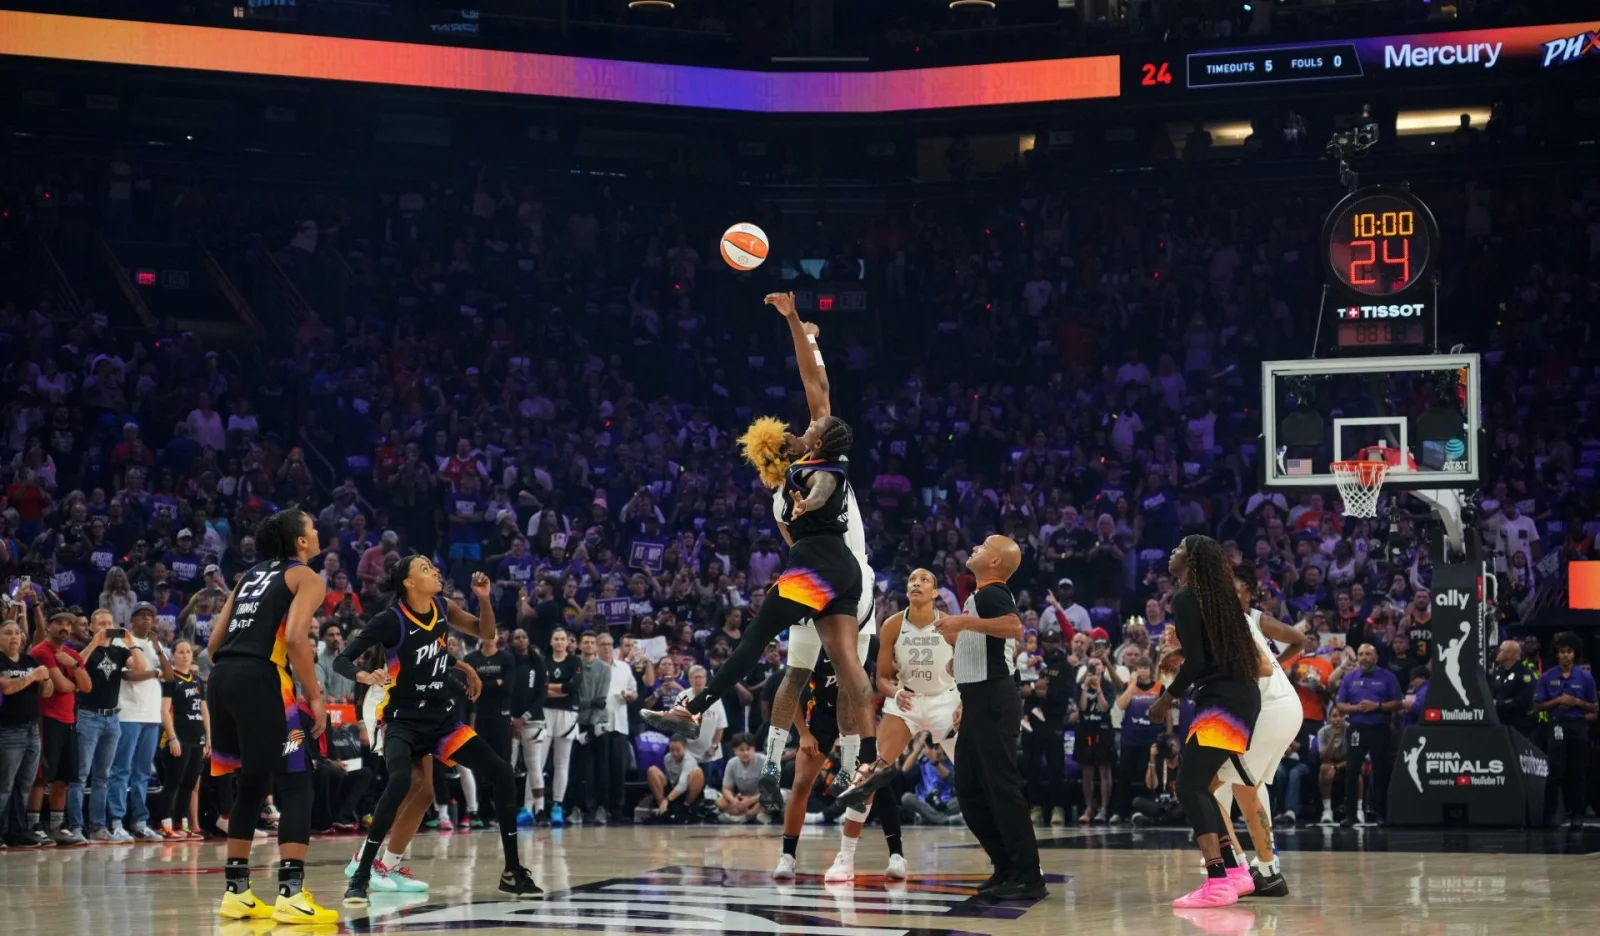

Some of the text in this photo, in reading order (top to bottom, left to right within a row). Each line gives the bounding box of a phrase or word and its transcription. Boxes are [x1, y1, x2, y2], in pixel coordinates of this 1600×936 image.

[1291, 55, 1342, 69] FOULS 0
[1385, 42, 1503, 68] Mercury
[1141, 62, 1172, 86] 24
[1206, 60, 1273, 74] TIMEOUTS 5
[1354, 211, 1414, 238] 10:00
[1350, 238, 1409, 284] 24
[1360, 304, 1425, 318] TISSOT
[1443, 460, 1468, 471] AT&T
[237, 570, 281, 598] 25
[1436, 590, 1470, 610] ally
[236, 601, 260, 615] THOMAS
[611, 601, 628, 614] MVP
[415, 631, 447, 665] PHX
[902, 636, 940, 646] ACES
[908, 648, 934, 666] 22
[432, 654, 448, 677] 14
[911, 668, 932, 681] ring
[184, 686, 199, 698] PHX
[1441, 708, 1484, 721] YouTube TV
[1425, 751, 1461, 760] WNBA
[1425, 760, 1504, 774] FINALS
[1519, 749, 1550, 778] coinbase
[1470, 776, 1496, 786] YouTube
[1497, 776, 1505, 785] TV
